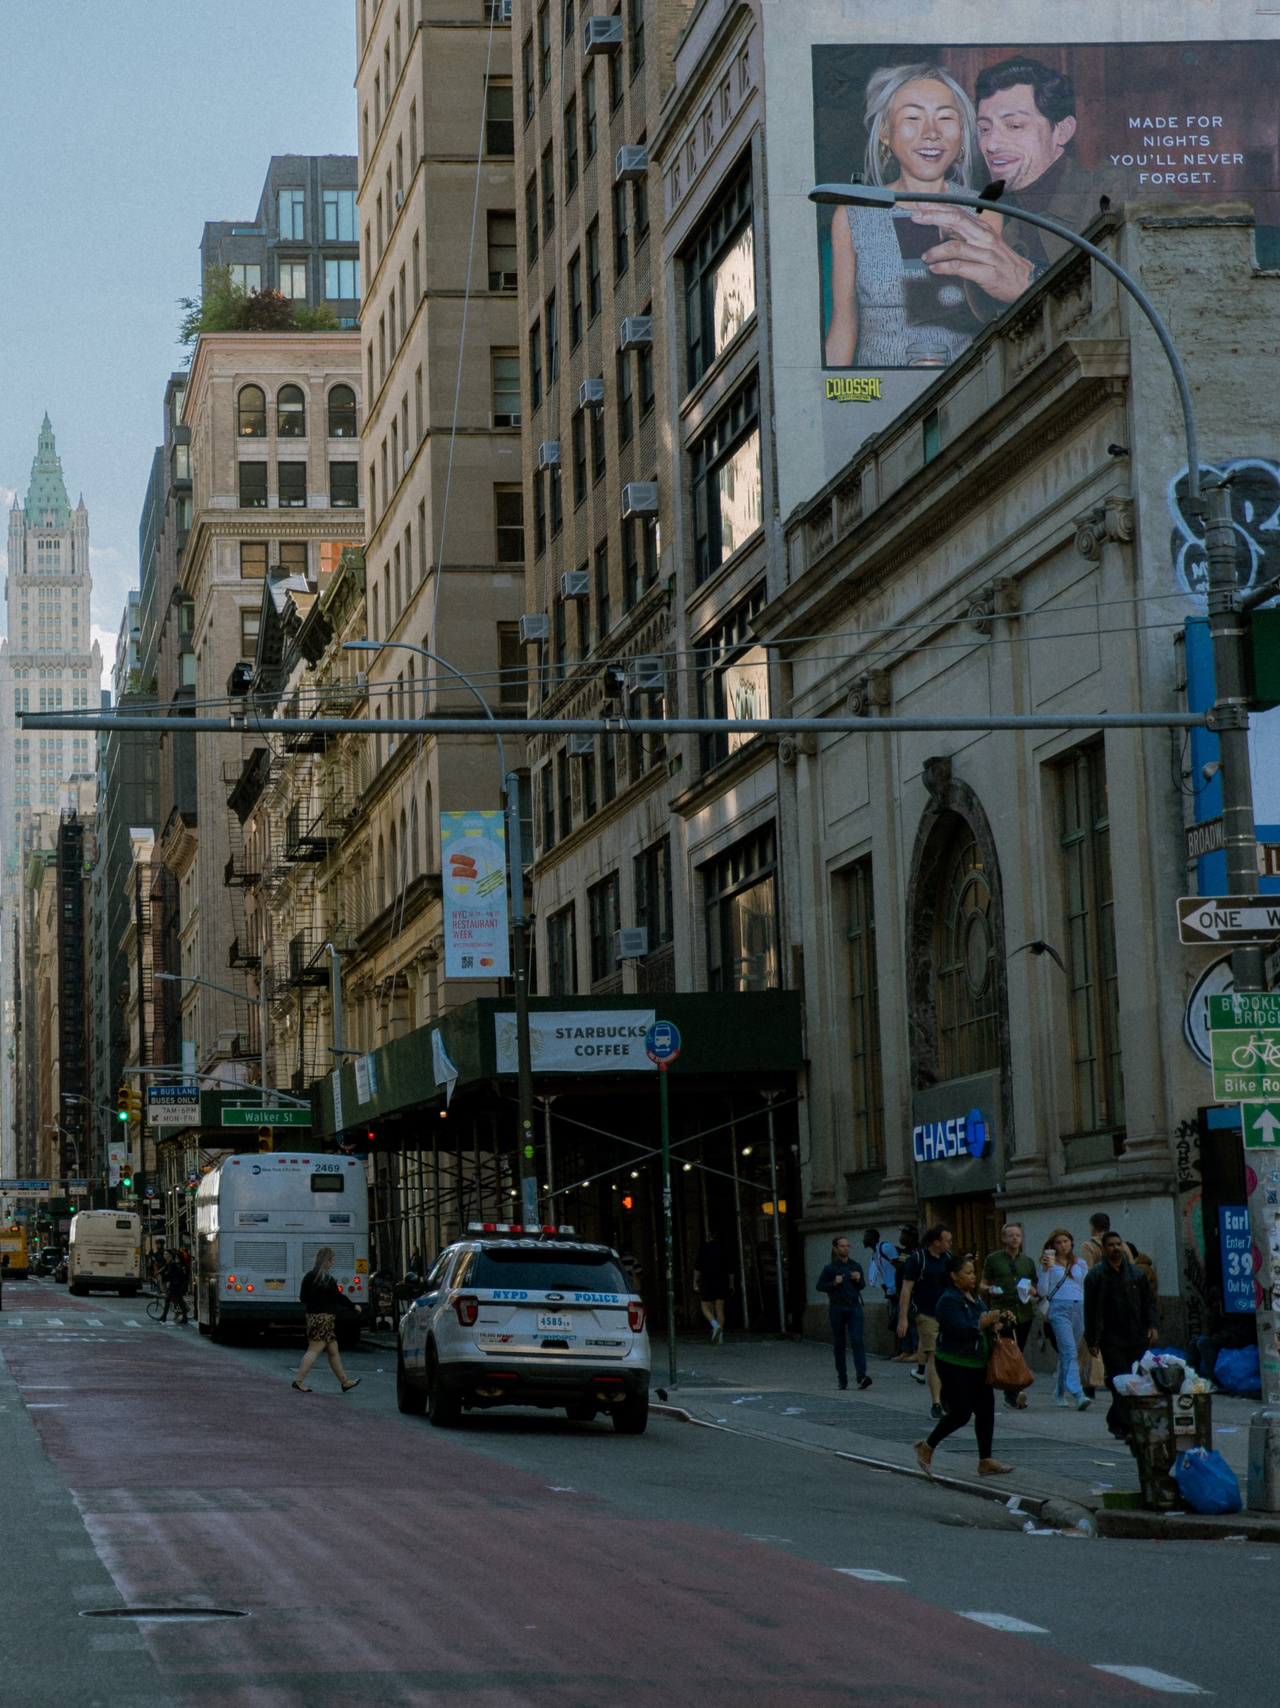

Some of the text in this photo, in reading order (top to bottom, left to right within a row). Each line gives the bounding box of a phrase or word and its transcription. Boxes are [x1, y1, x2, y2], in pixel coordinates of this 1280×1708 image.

[1128, 115, 1223, 129] MADE FOR
[1143, 135, 1211, 147] NIGHTS
[1110, 153, 1244, 166] YOU'LL NEVER
[1139, 172, 1217, 184] FORGET.
[825, 378, 883, 399] COLOSSAL
[451, 909, 467, 919] NYC
[1199, 910, 1242, 929] ONE
[452, 918, 498, 929] RESTAURANT
[452, 930, 473, 939] WEEK
[1221, 997, 1280, 1011] BOOKL
[555, 1025, 647, 1039] STARBUCKS
[574, 1044, 630, 1057] COFFEE
[160, 1088, 197, 1096] BUS LANE
[1224, 1078, 1256, 1093] Bike
[244, 1112, 293, 1122] Walker St
[913, 1116, 968, 1162] CHASE
[314, 1164, 340, 1173] 2469
[1226, 1235, 1245, 1249] Enter
[1228, 1252, 1253, 1276] 39
[1228, 1279, 1239, 1293] Out
[1240, 1278, 1250, 1296] by
[493, 1290, 619, 1303] NYPD POLICE
[540, 1316, 563, 1326] 4585
